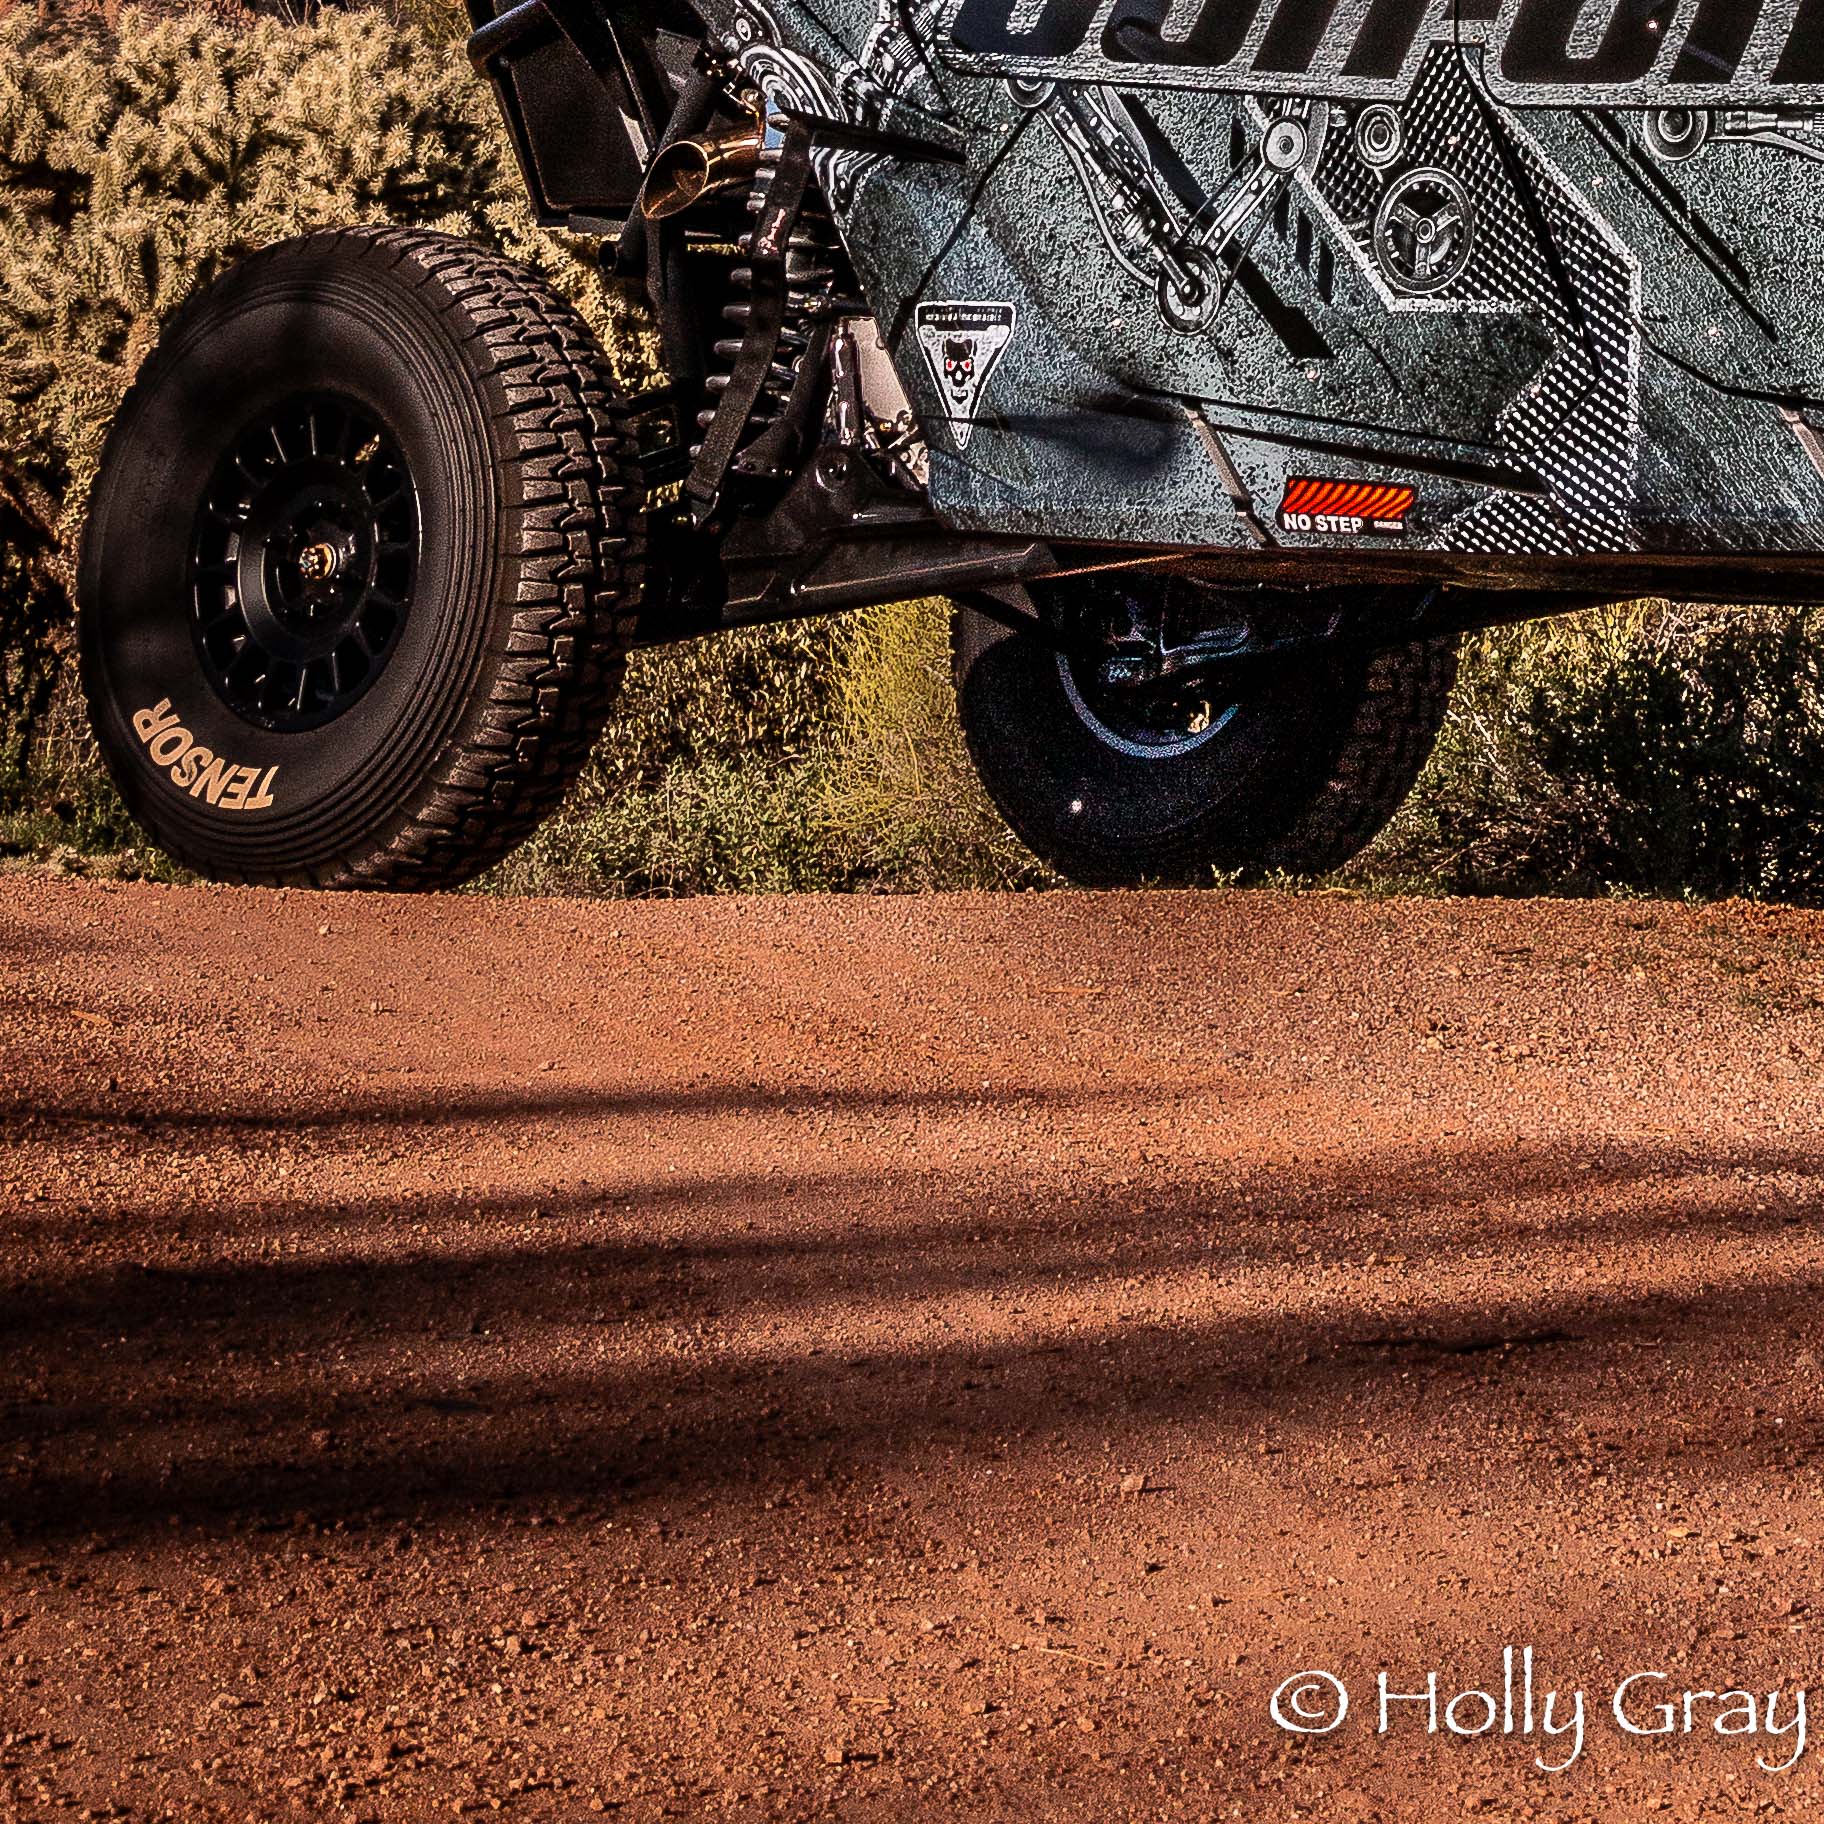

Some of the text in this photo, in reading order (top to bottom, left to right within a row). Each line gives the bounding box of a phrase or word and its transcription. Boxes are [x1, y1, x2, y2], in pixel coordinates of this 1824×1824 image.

[1283, 513, 1311, 531] NO
[1314, 515, 1363, 533] STEP
[132, 697, 280, 810] TENSOR
